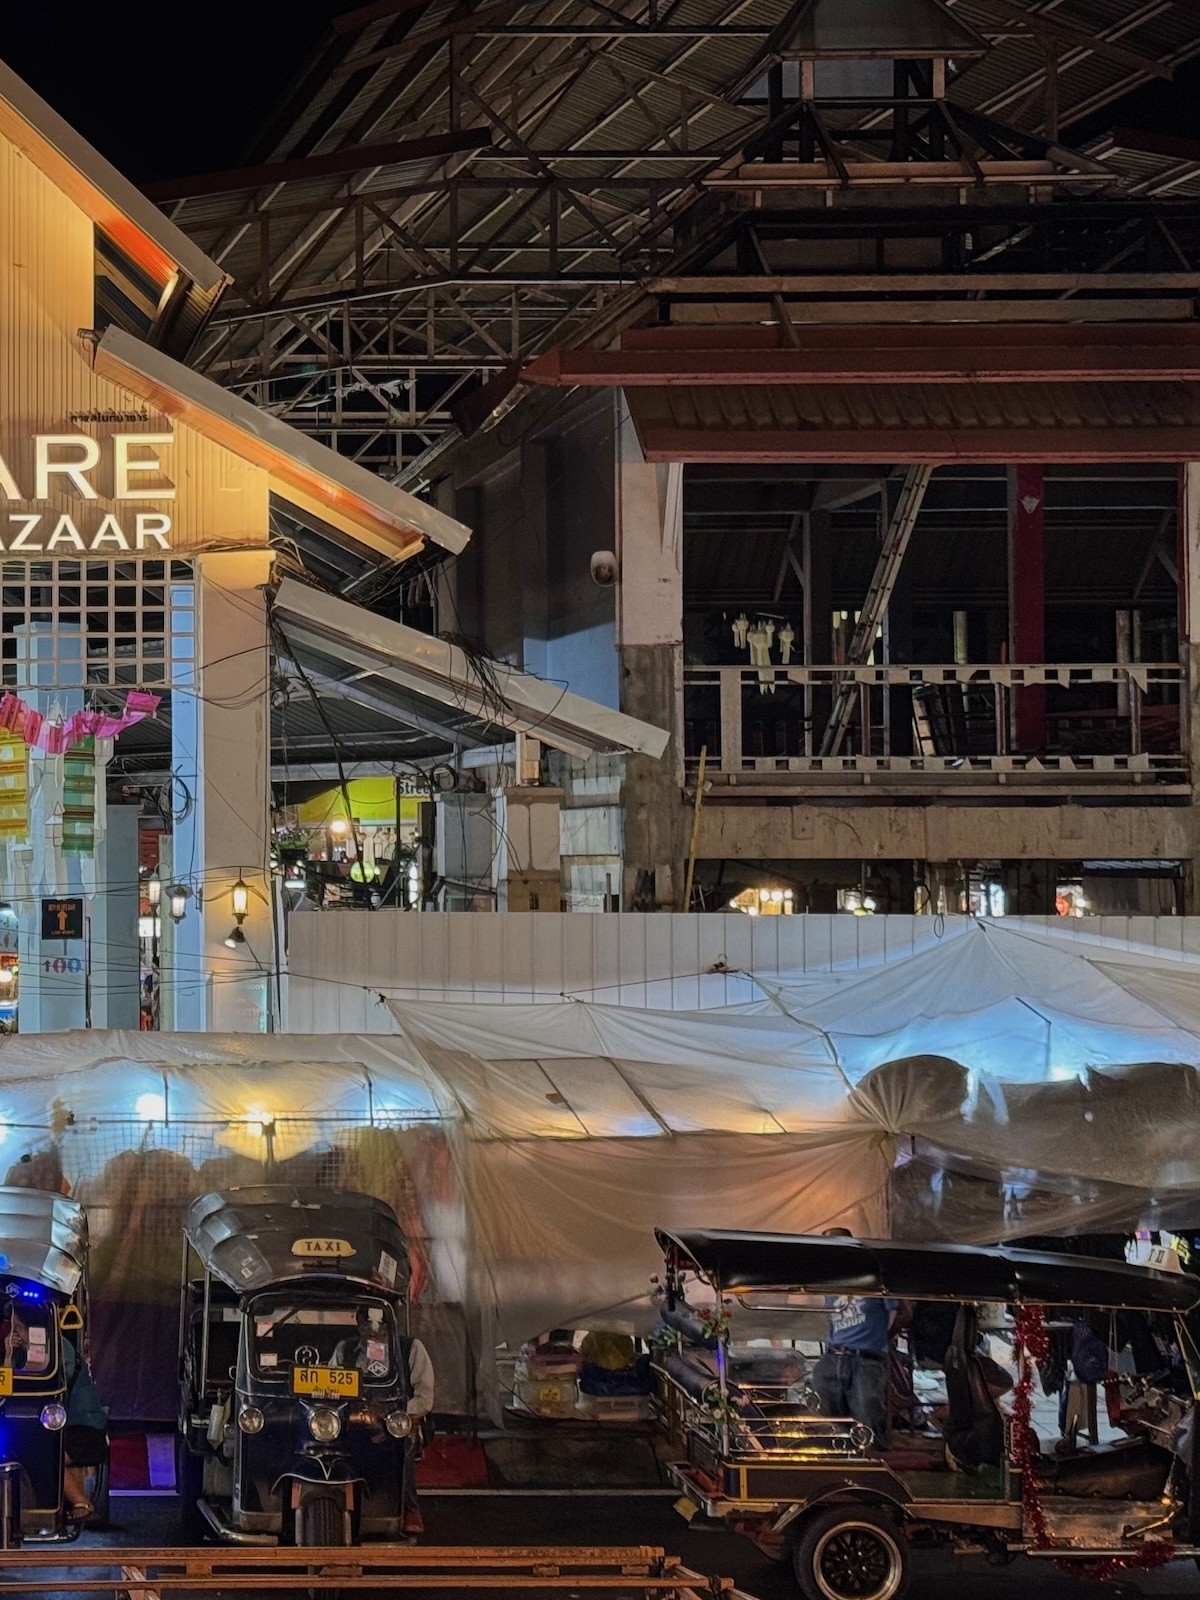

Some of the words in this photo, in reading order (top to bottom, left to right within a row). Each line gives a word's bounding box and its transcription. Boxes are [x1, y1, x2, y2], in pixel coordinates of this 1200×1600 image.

[304, 1241, 341, 1252] TAXI
[299, 1368, 319, 1384] สก
[329, 1371, 354, 1385] 525
